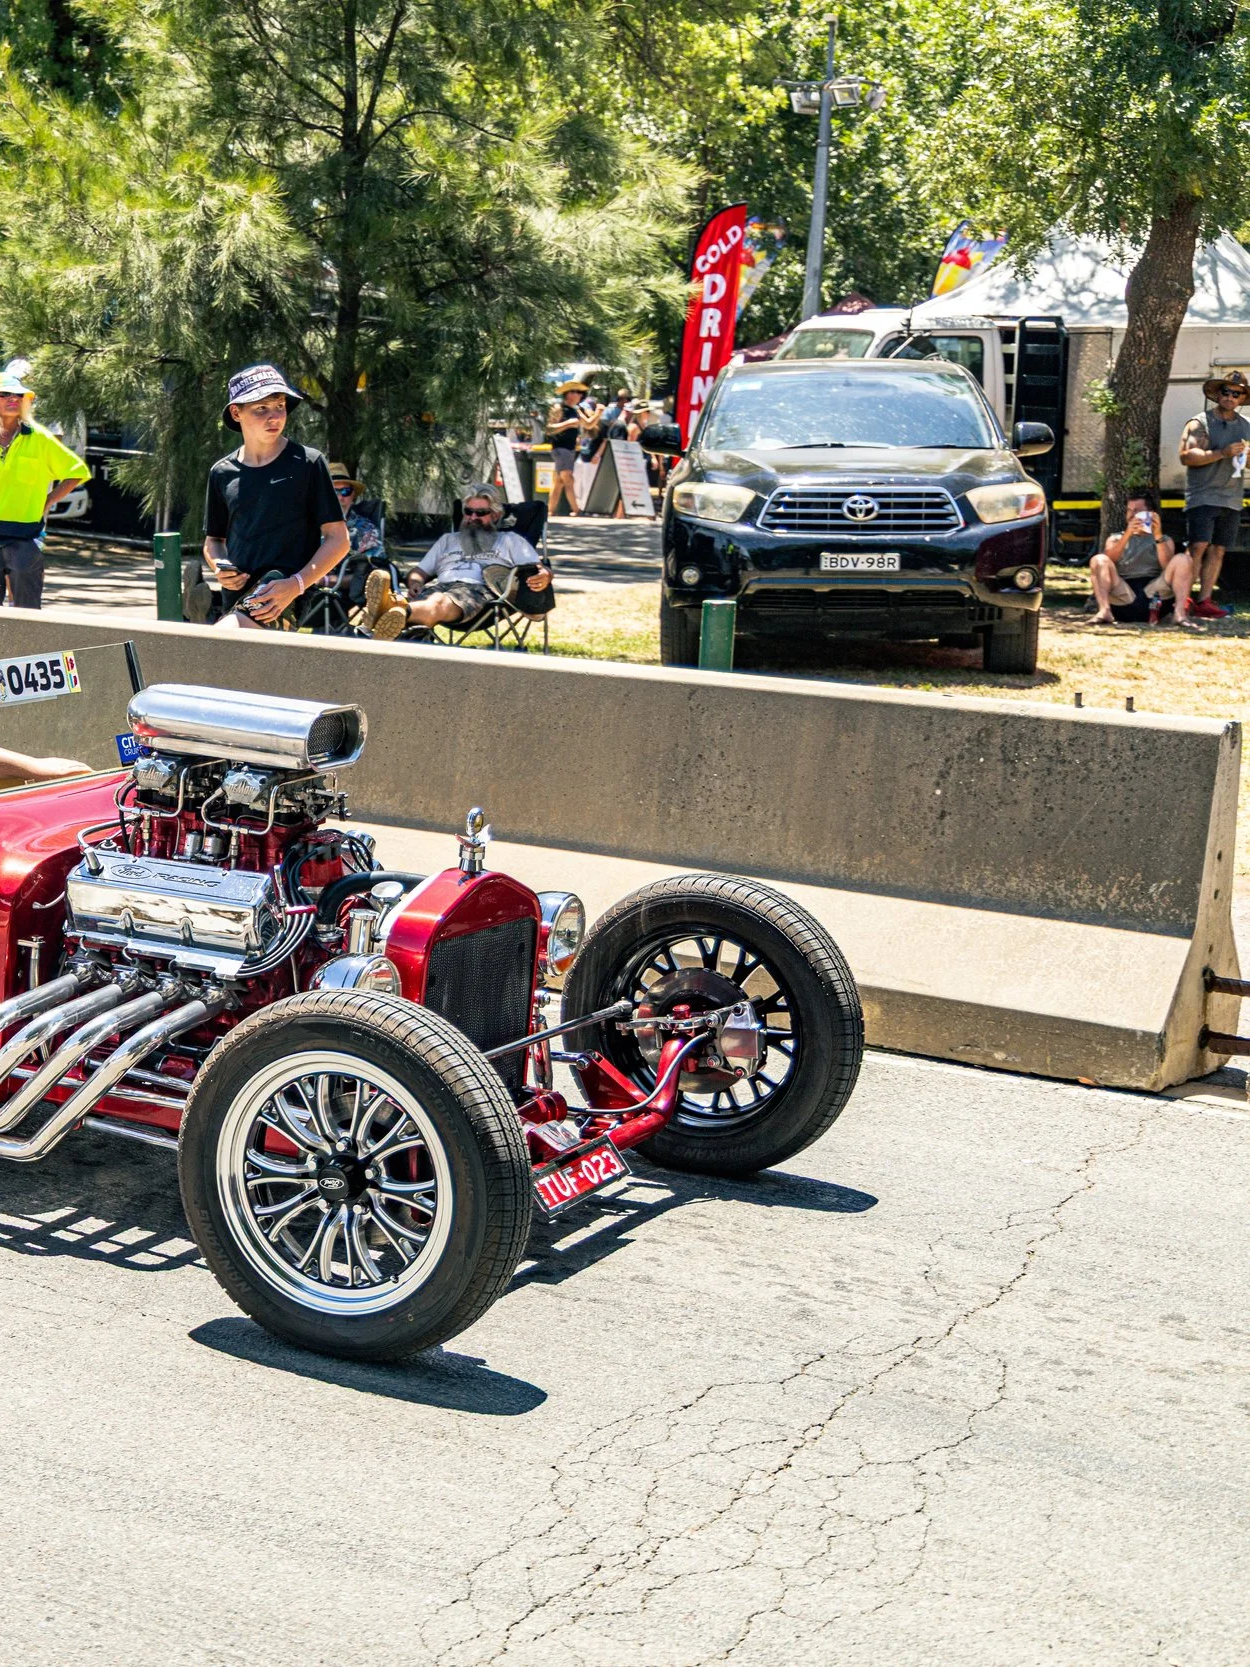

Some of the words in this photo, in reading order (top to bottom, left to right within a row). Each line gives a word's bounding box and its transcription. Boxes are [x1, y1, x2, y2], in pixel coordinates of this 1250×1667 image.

[695, 224, 742, 273] COLD
[6, 659, 65, 695] 0435
[121, 735, 137, 749] CIT
[118, 865, 145, 878] Ford
[153, 872, 222, 888] RACING
